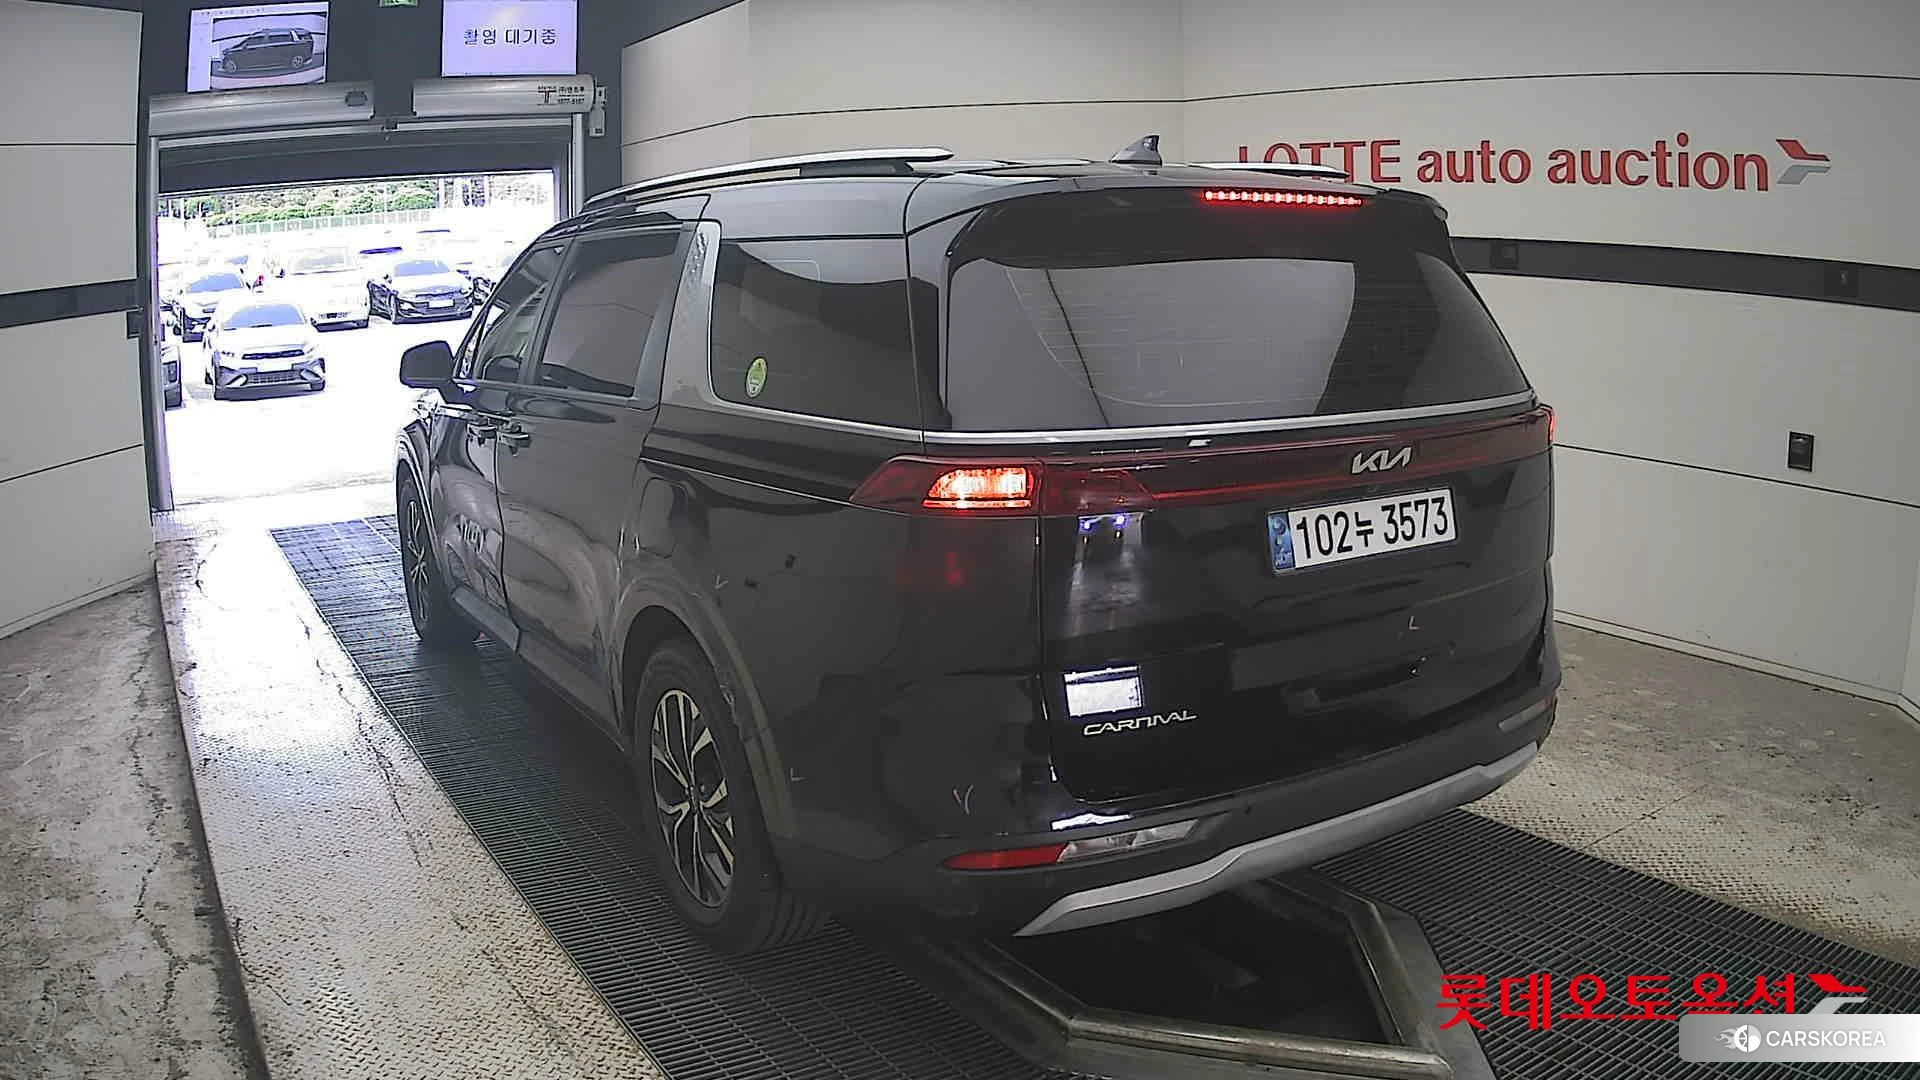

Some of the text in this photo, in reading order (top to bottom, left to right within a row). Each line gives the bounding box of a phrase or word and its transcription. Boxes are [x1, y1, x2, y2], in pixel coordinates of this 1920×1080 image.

[505, 28, 557, 45] 대기중
[1417, 139, 1532, 184] auto
[1547, 132, 1768, 191] auction
[1351, 447, 1413, 474] KIA
[1296, 496, 1448, 559] 102누 3573
[1083, 710, 1197, 736] CARNIVAL
